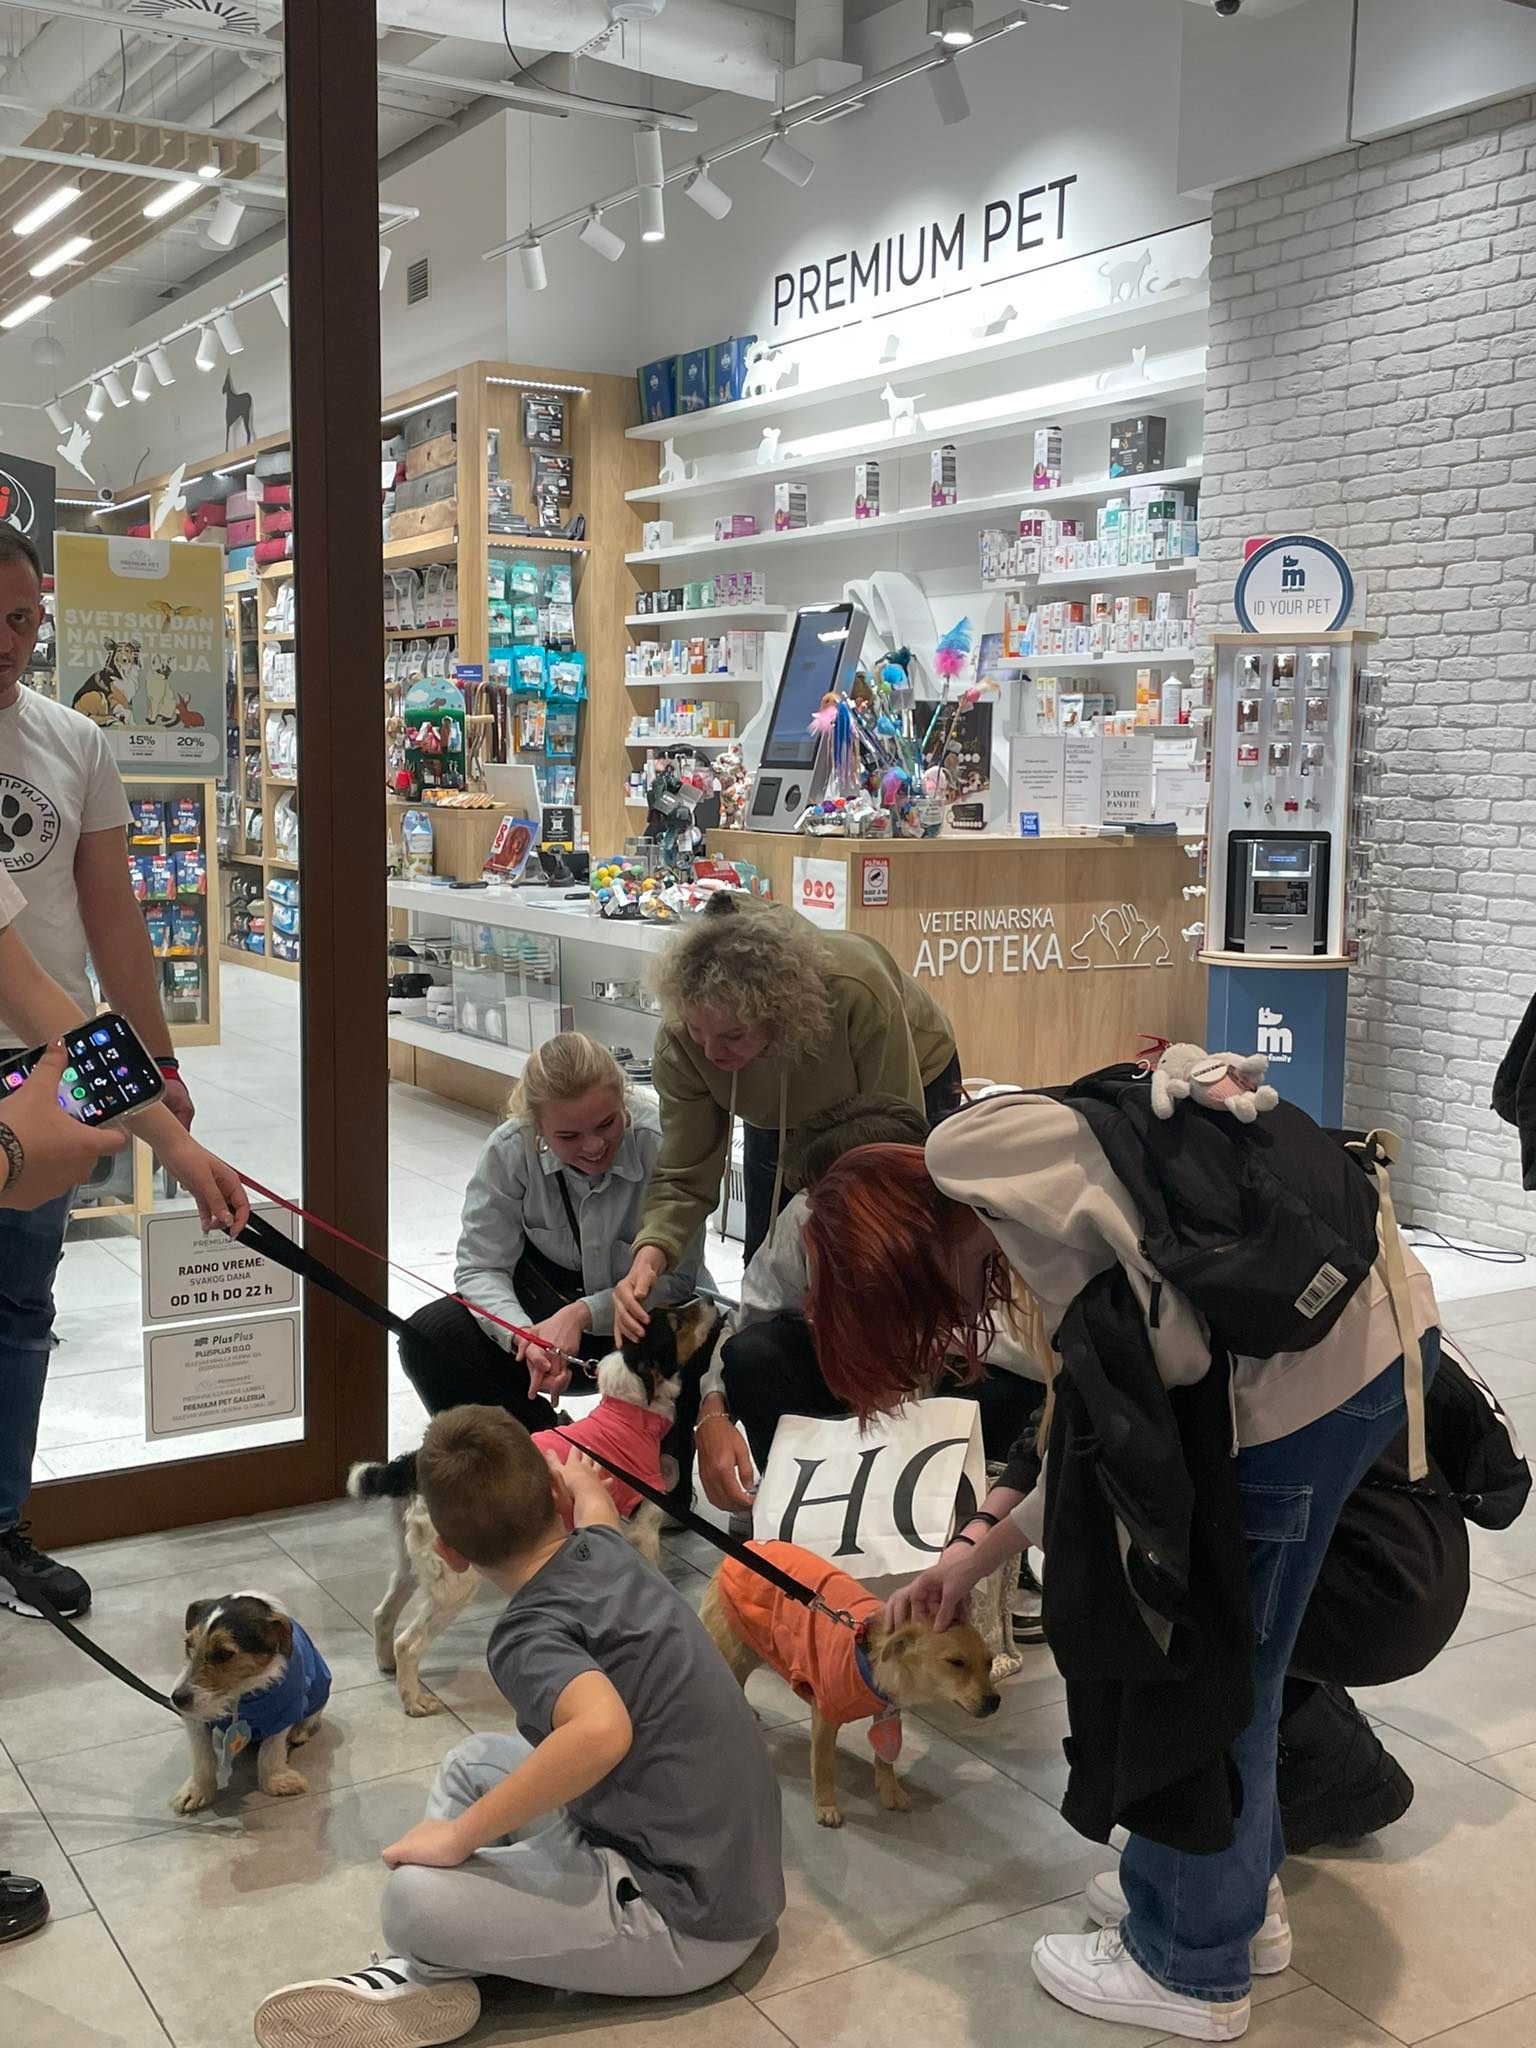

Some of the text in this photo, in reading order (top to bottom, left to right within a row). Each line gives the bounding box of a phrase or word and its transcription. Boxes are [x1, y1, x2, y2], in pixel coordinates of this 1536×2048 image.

[774, 174, 1077, 326] PREMIUM PET
[1254, 598, 1331, 616] ID YOUR PET
[64, 608, 214, 632] SVETSKI DAN
[129, 736, 155, 745] 15%
[177, 737, 205, 747] 20%
[919, 907, 1055, 934] VETERINARSKA
[913, 933, 1064, 978] APOTEKA
[178, 1257, 265, 1276] RADNO VREME:
[190, 1271, 251, 1286] SVAKOG DANA
[170, 1284, 273, 1306] OD 10 h DO 22 h
[195, 1346, 231, 1358] PLUSPLUS
[183, 1400, 217, 1411] PREMIUM
[219, 1398, 231, 1406] PET
